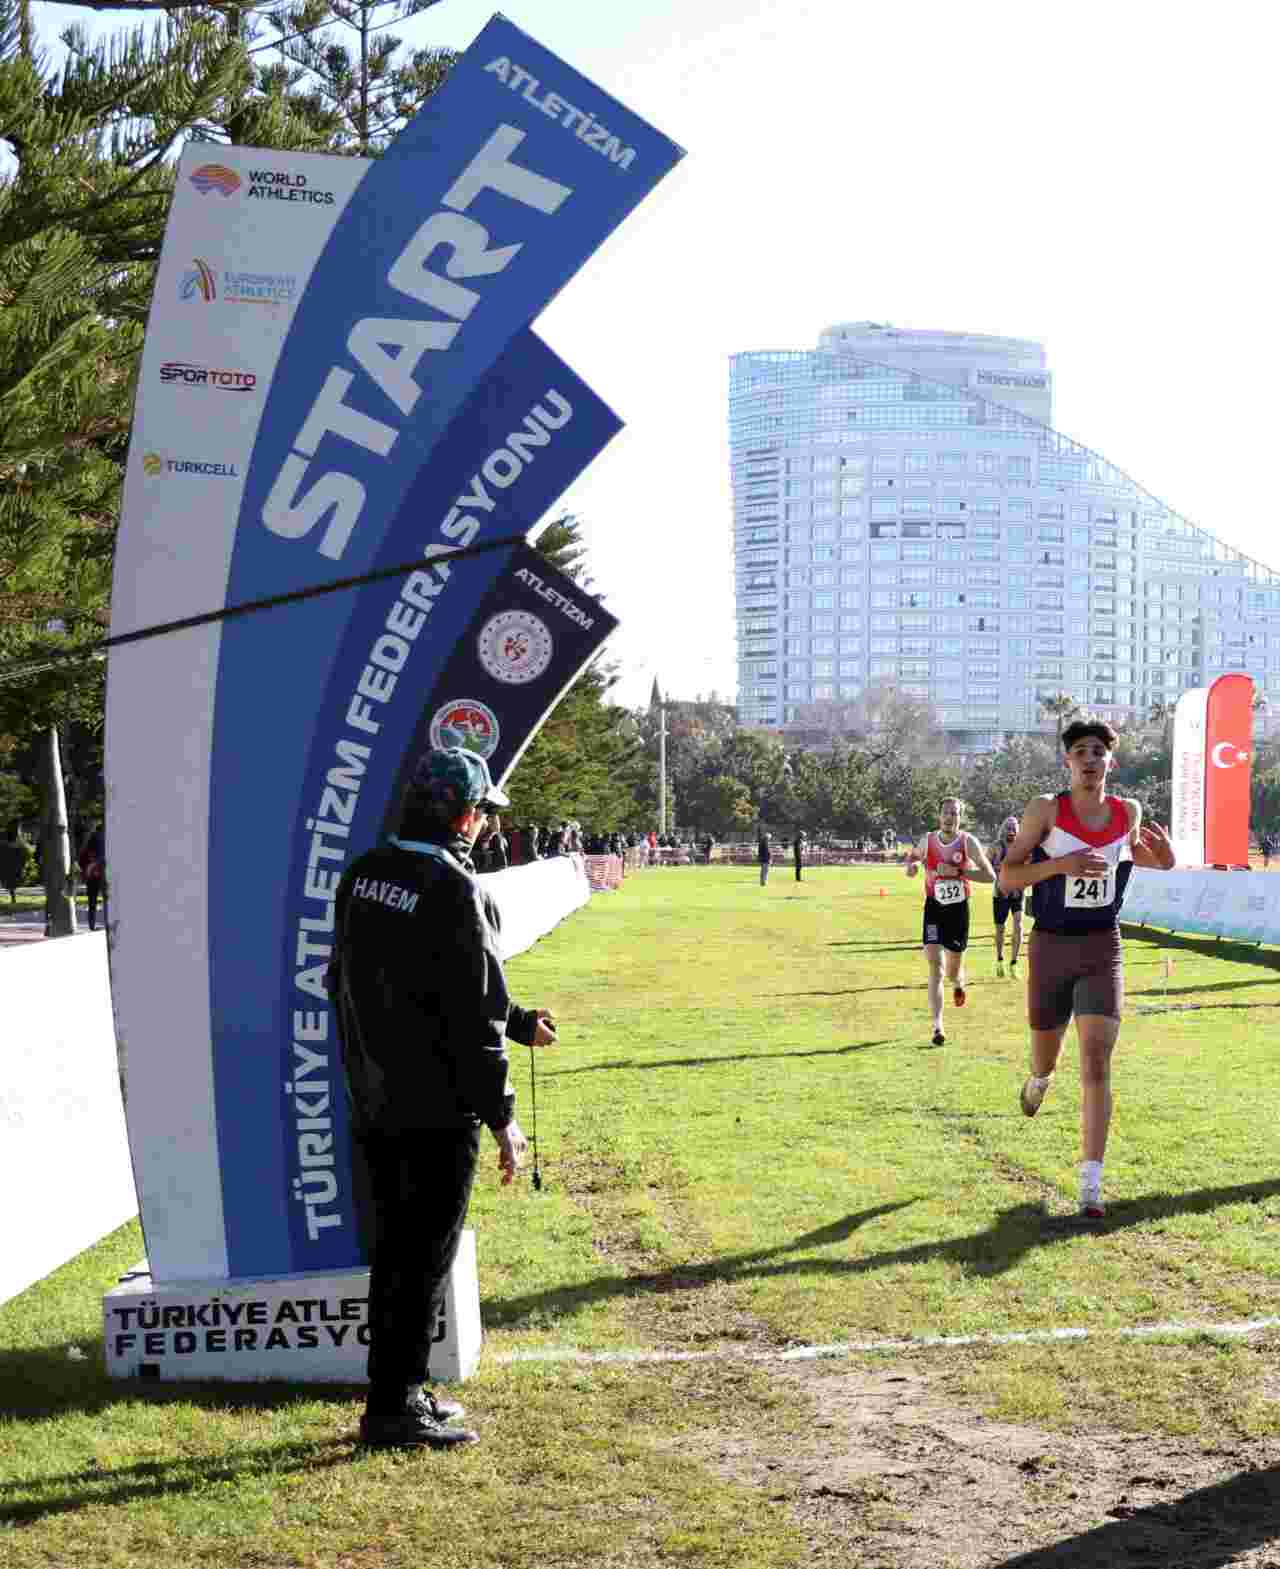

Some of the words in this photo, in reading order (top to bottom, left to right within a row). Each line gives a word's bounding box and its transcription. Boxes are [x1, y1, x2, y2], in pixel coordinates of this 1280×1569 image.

[483, 55, 637, 172] ATLETİZM
[247, 186, 335, 205] ATHLETICS
[249, 170, 307, 186] WORLD
[263, 123, 575, 562] START
[167, 459, 239, 478] TURKCELL
[344, 388, 574, 736] FEDERASYONU
[513, 567, 595, 631] ATLETİZM
[294, 739, 373, 1001] ATLETİZM
[1073, 878, 1108, 900] 241
[284, 1010, 342, 1241] TÜRKİYE
[112, 1298, 269, 1330] TÜRKİYE
